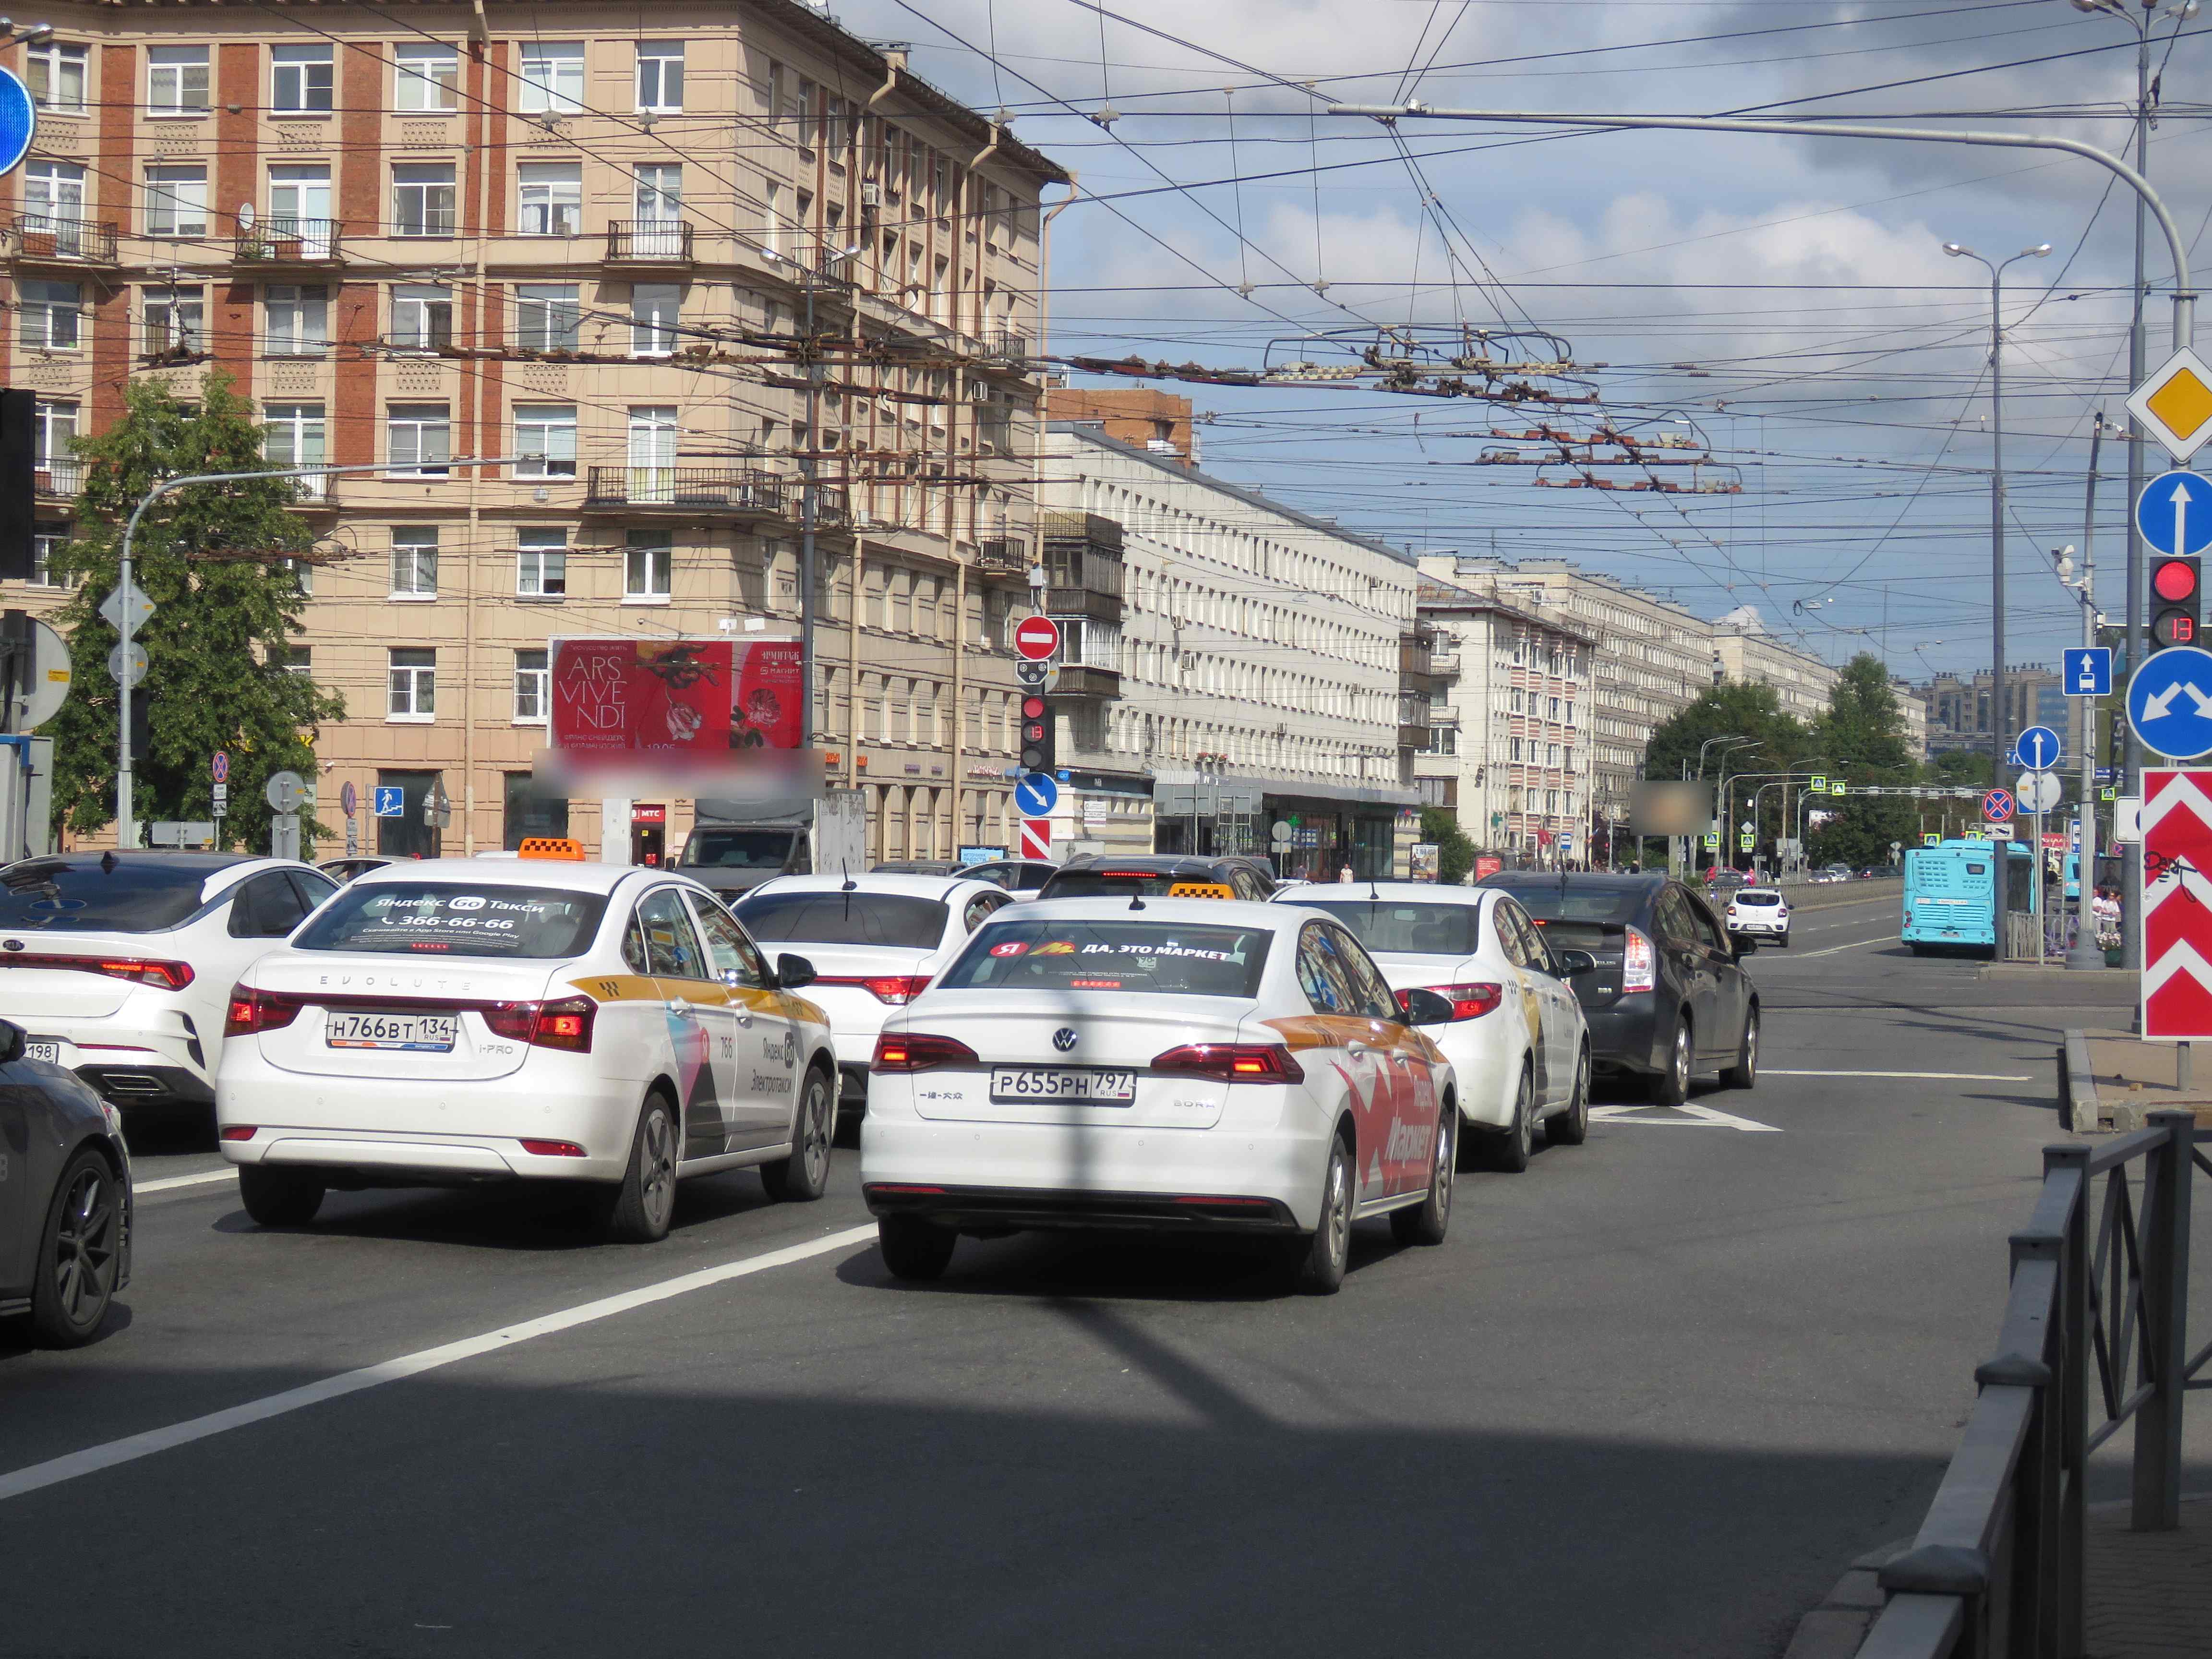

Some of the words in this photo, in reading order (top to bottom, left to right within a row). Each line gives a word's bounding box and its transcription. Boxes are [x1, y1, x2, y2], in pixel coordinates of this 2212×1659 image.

[2173, 618, 2192, 640] 13
[566, 656, 622, 684] ARS
[558, 680, 627, 705] VIVE
[576, 705, 625, 729] NDI
[374, 899, 446, 907] Яндекс
[489, 900, 546, 914] Такси
[398, 915, 515, 929] 366-66-66
[1081, 944, 1115, 954] ДА,
[1118, 945, 1153, 954] ЭТО
[1154, 946, 1231, 961] МАРКЕТ
[319, 975, 471, 990] EVOLUTE
[419, 1018, 449, 1035] 134
[28, 1045, 52, 1058] 198
[720, 1037, 733, 1059] 766
[763, 1037, 784, 1063] Яндекс
[750, 1069, 791, 1095] Электротакси
[1094, 1073, 1129, 1090] 797
[1383, 1117, 1432, 1169] Маркет
